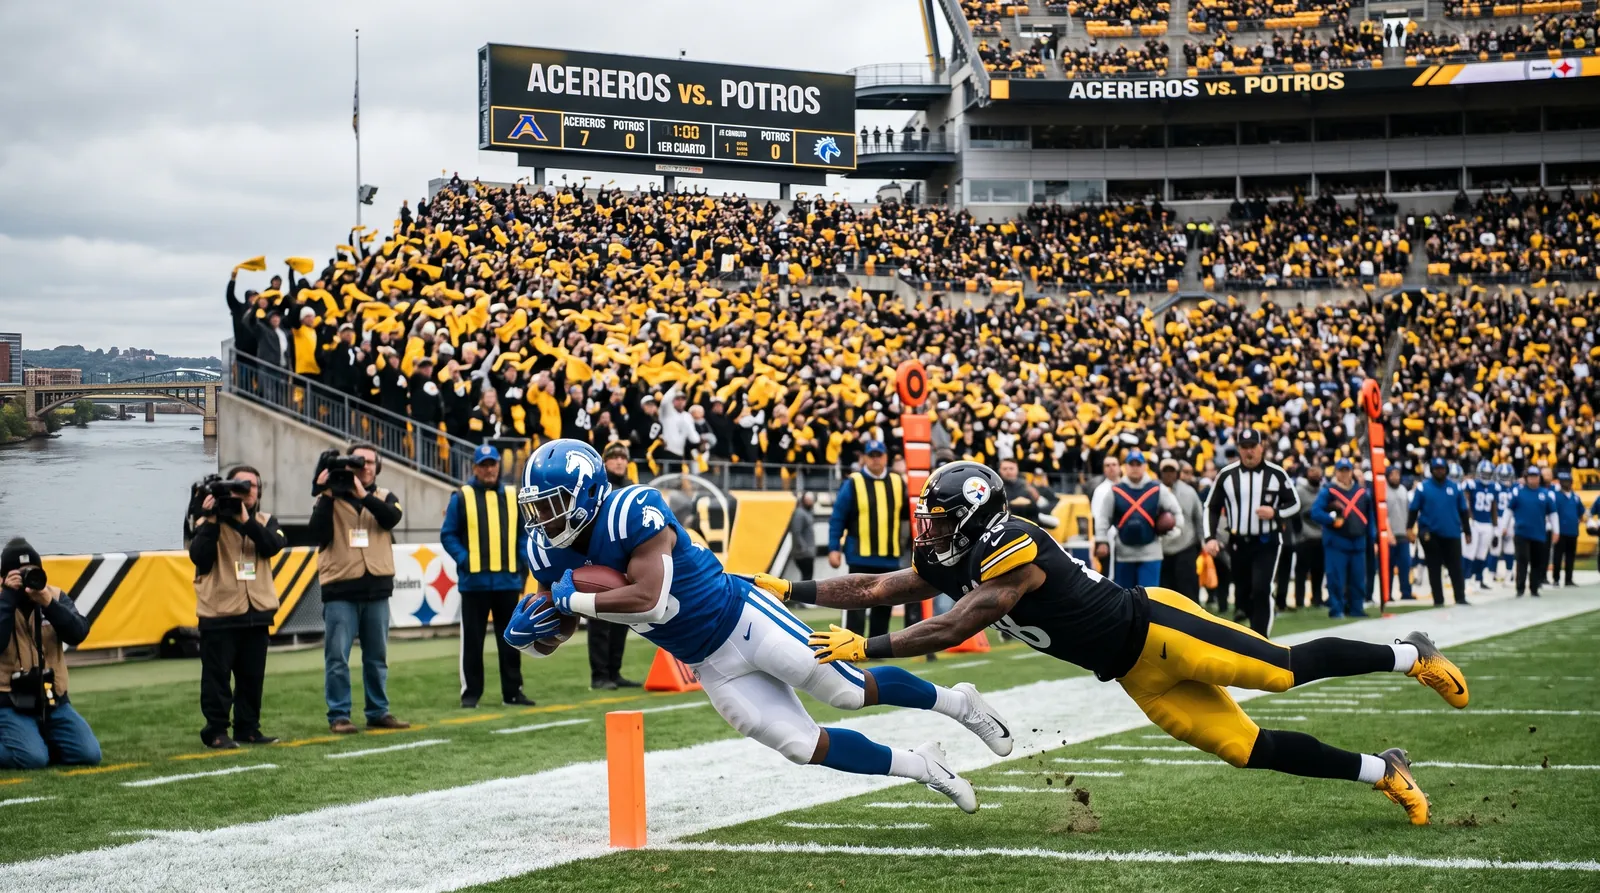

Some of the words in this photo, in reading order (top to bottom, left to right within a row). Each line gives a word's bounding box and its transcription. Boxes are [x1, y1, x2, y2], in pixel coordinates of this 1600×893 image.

[527, 62, 671, 103] ACEREROS
[721, 79, 820, 114] POTROS
[1069, 79, 1199, 99] ACEREROS
[1245, 72, 1345, 94] POTROS
[564, 116, 606, 129] ACEREROS
[614, 120, 645, 132] POTROS
[580, 130, 590, 146] 7
[625, 133, 635, 149] 0
[761, 130, 791, 142] POTROS
[657, 141, 673, 152] 1ER
[674, 143, 706, 155] CUARTO
[725, 142, 730, 153] 1
[771, 143, 780, 159] 0
